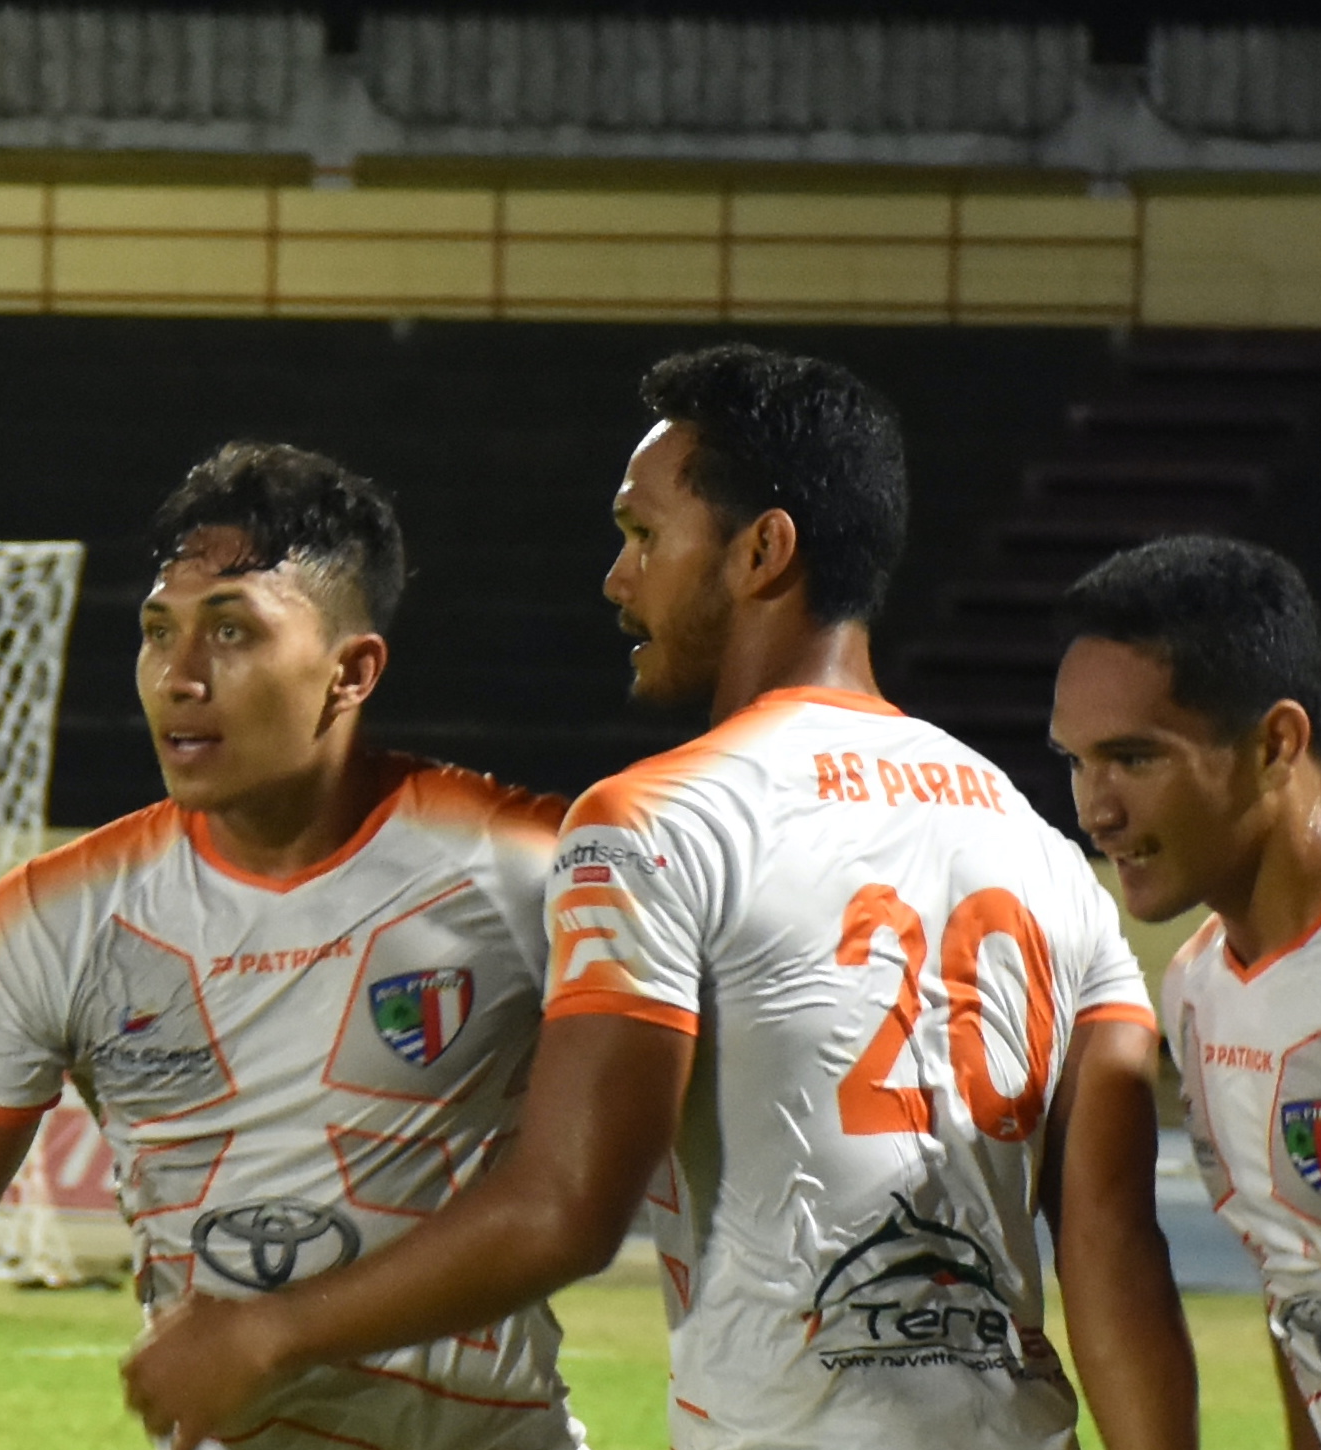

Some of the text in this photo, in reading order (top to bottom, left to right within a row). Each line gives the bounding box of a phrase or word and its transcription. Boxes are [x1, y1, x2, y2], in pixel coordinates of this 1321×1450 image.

[813, 752, 1007, 816] AS PIRAE
[835, 883, 1056, 1142] 20
